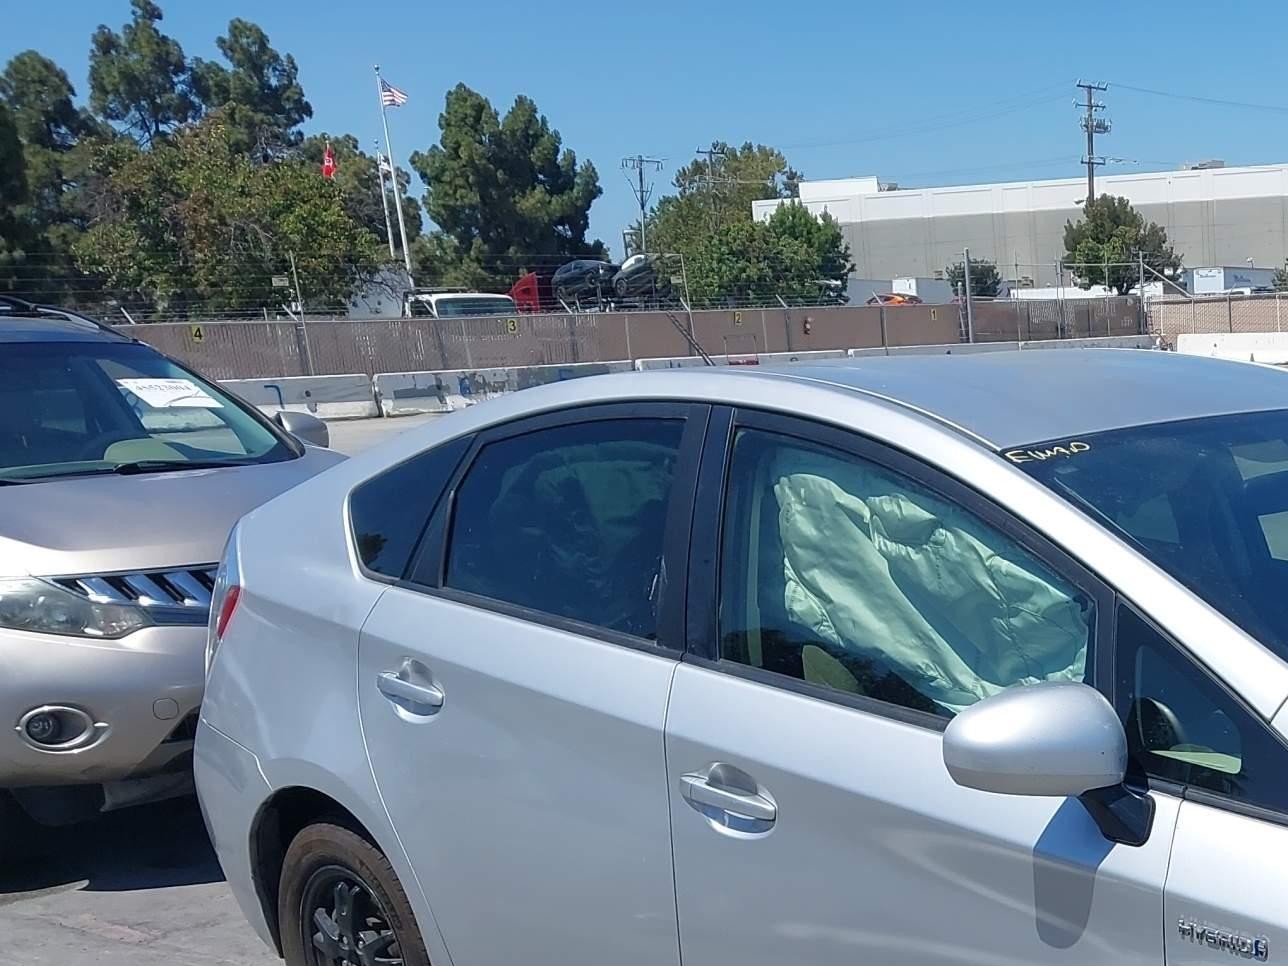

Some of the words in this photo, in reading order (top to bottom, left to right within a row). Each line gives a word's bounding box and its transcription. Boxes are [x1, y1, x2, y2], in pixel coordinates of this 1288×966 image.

[508, 319, 517, 332] 3
[194, 327, 203, 340] 4
[1178, 917, 1254, 956] HYBRID
